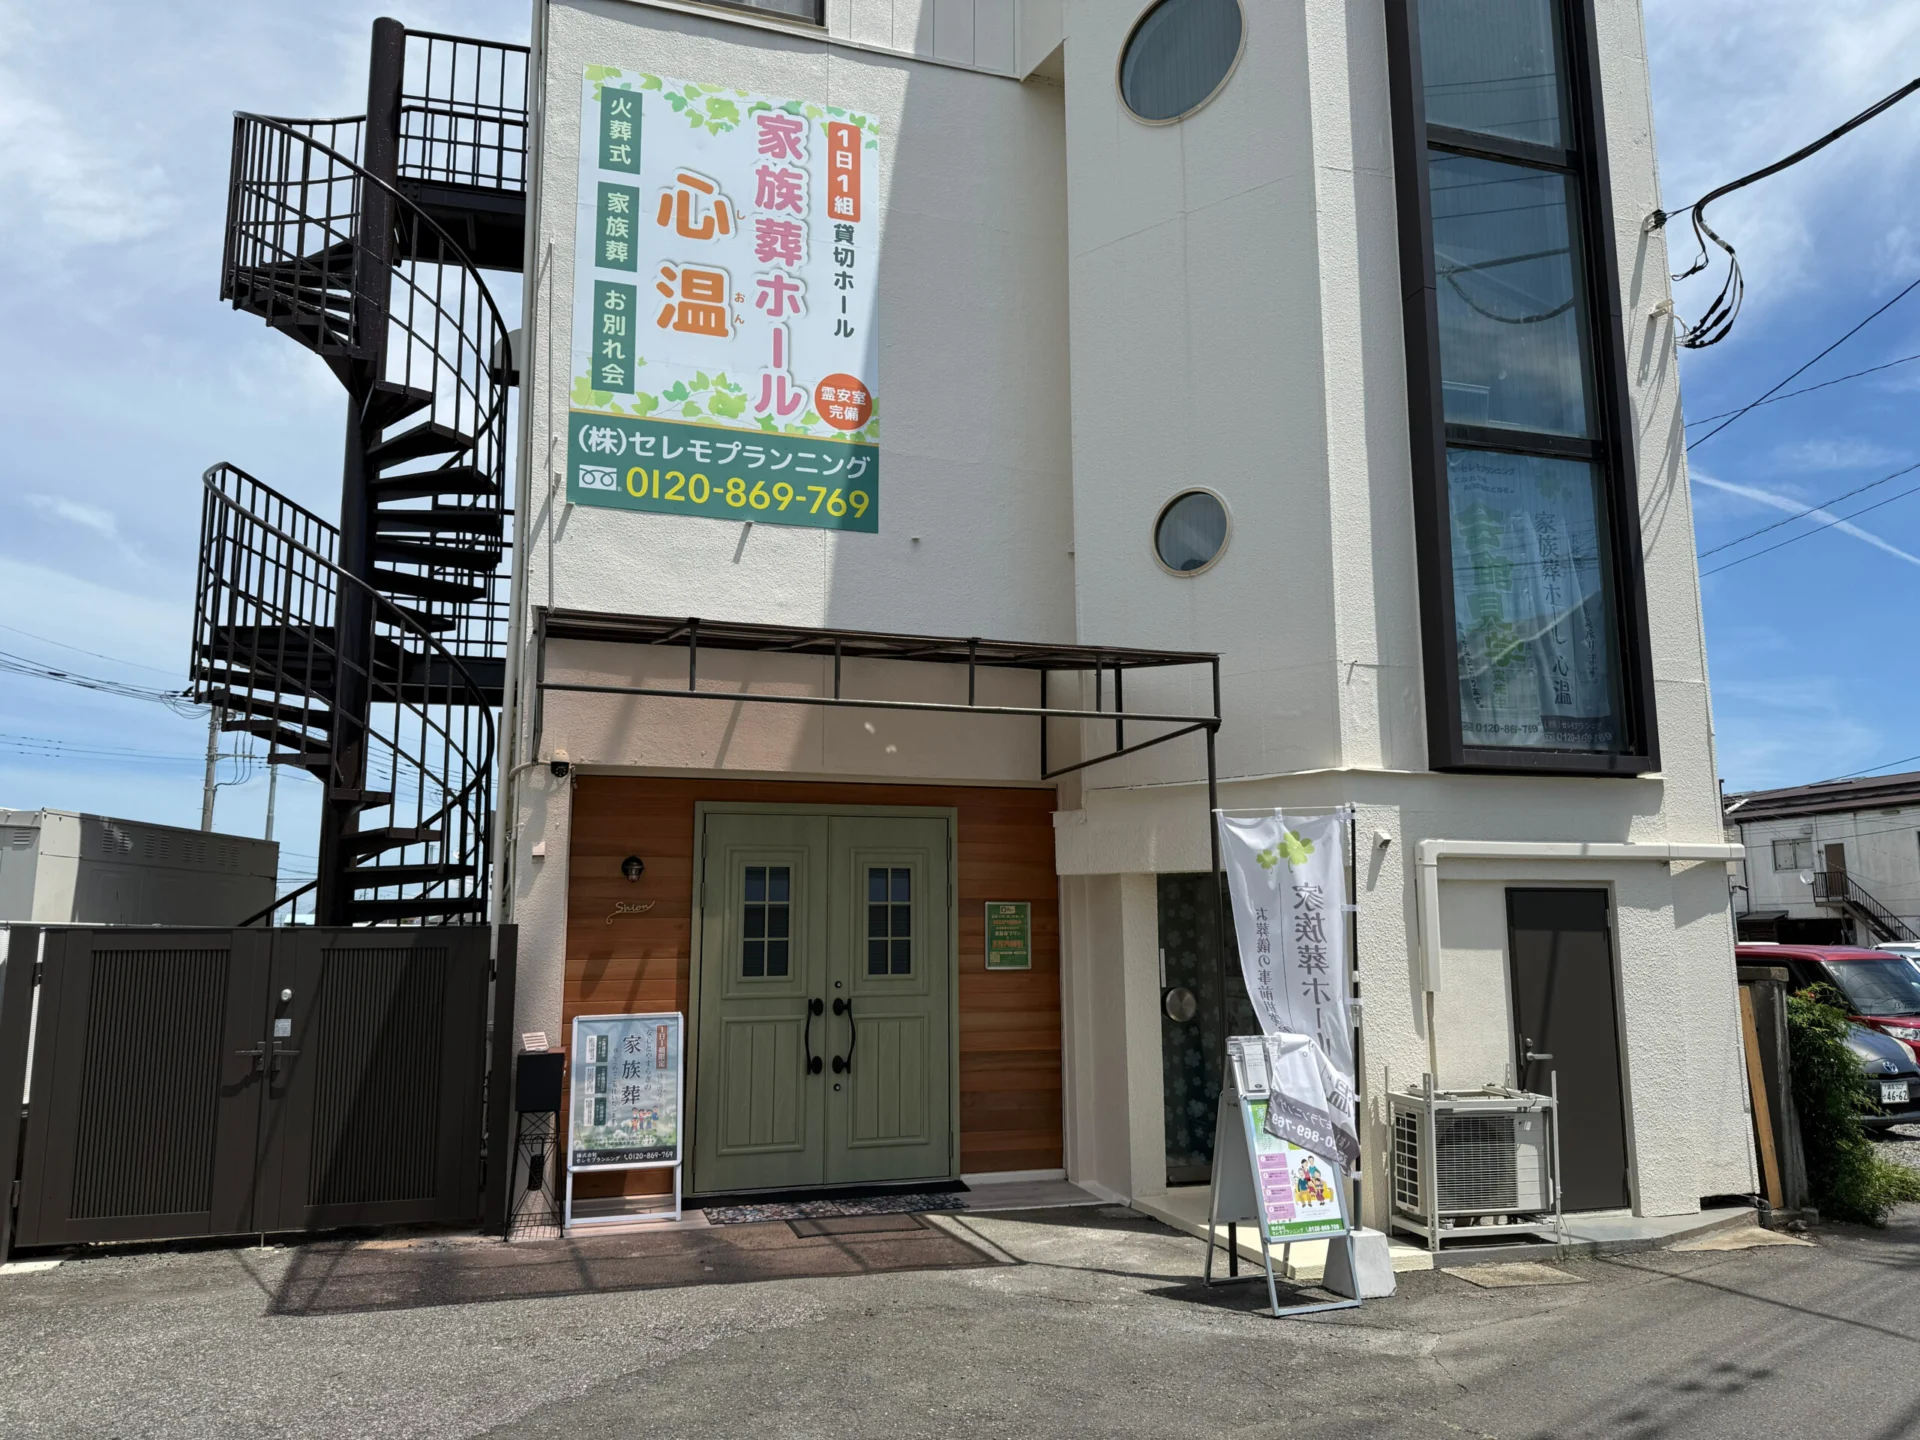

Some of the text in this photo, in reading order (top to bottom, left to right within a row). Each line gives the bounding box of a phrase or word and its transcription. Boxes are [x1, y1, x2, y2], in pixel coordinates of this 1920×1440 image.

[609, 98, 633, 165] 火葬式
[605, 192, 630, 263] 家族葬
[656, 173, 730, 338] 心温
[833, 128, 855, 338] 1日1組 貸切ホール
[754, 113, 804, 416] 家族葬ホール
[734, 292, 746, 325] おん
[602, 290, 626, 386] お別れ会
[821, 386, 866, 406] 霊安室
[829, 404, 859, 422] 完備
[578, 424, 870, 480] (株)セレモプランニング
[625, 466, 870, 518] 0120-869-769
[1552, 655, 1573, 706] 心温
[620, 1034, 641, 1106] 家族葬
[576, 1155, 620, 1164] セレモプランニング
[628, 1151, 673, 1160] 0120-869-769
